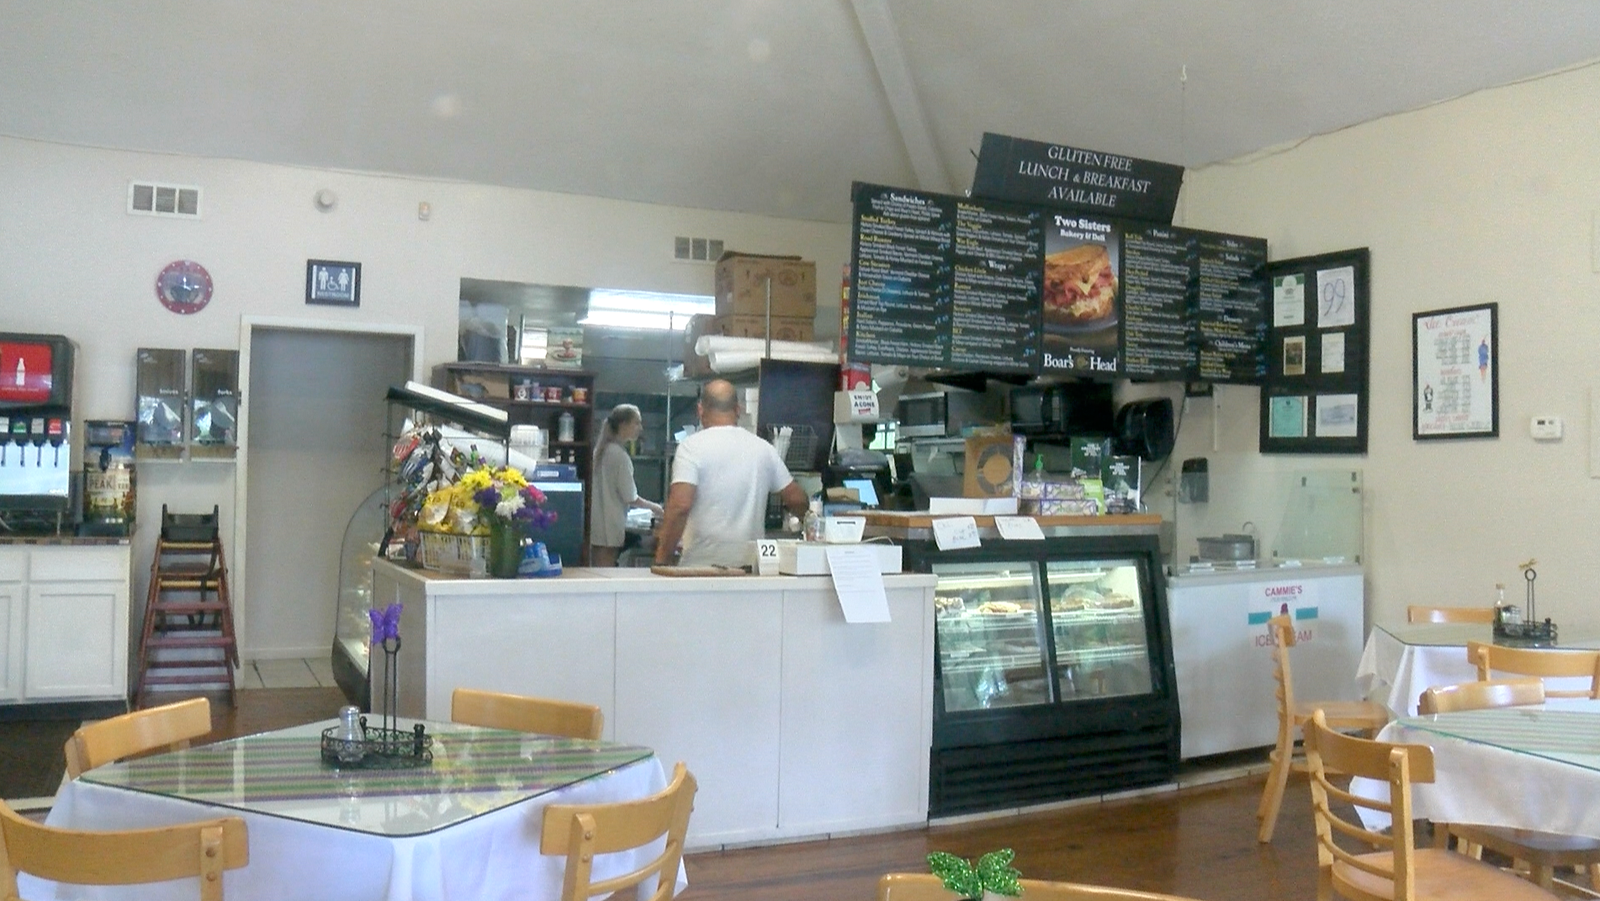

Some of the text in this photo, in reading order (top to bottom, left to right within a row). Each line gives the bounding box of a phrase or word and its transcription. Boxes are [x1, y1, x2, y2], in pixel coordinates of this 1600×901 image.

[1047, 146, 1133, 172] GLUTEN FREE
[1018, 160, 1151, 194] LUNCH & BREAKFAST
[890, 192, 925, 205] Sandwiches
[1047, 186, 1117, 208] AVAILABLE
[1054, 215, 1111, 233] Two Sisters
[1060, 229, 1084, 240] Bakery
[1092, 233, 1105, 242] Deli
[988, 260, 1007, 272] Wraps
[1324, 278, 1346, 317] 99
[1043, 353, 1074, 369] Boar's
[1089, 356, 1117, 372] Head
[88, 480, 113, 490] PEAK
[761, 544, 777, 557] 22
[1265, 585, 1303, 597] CAMMIE'S
